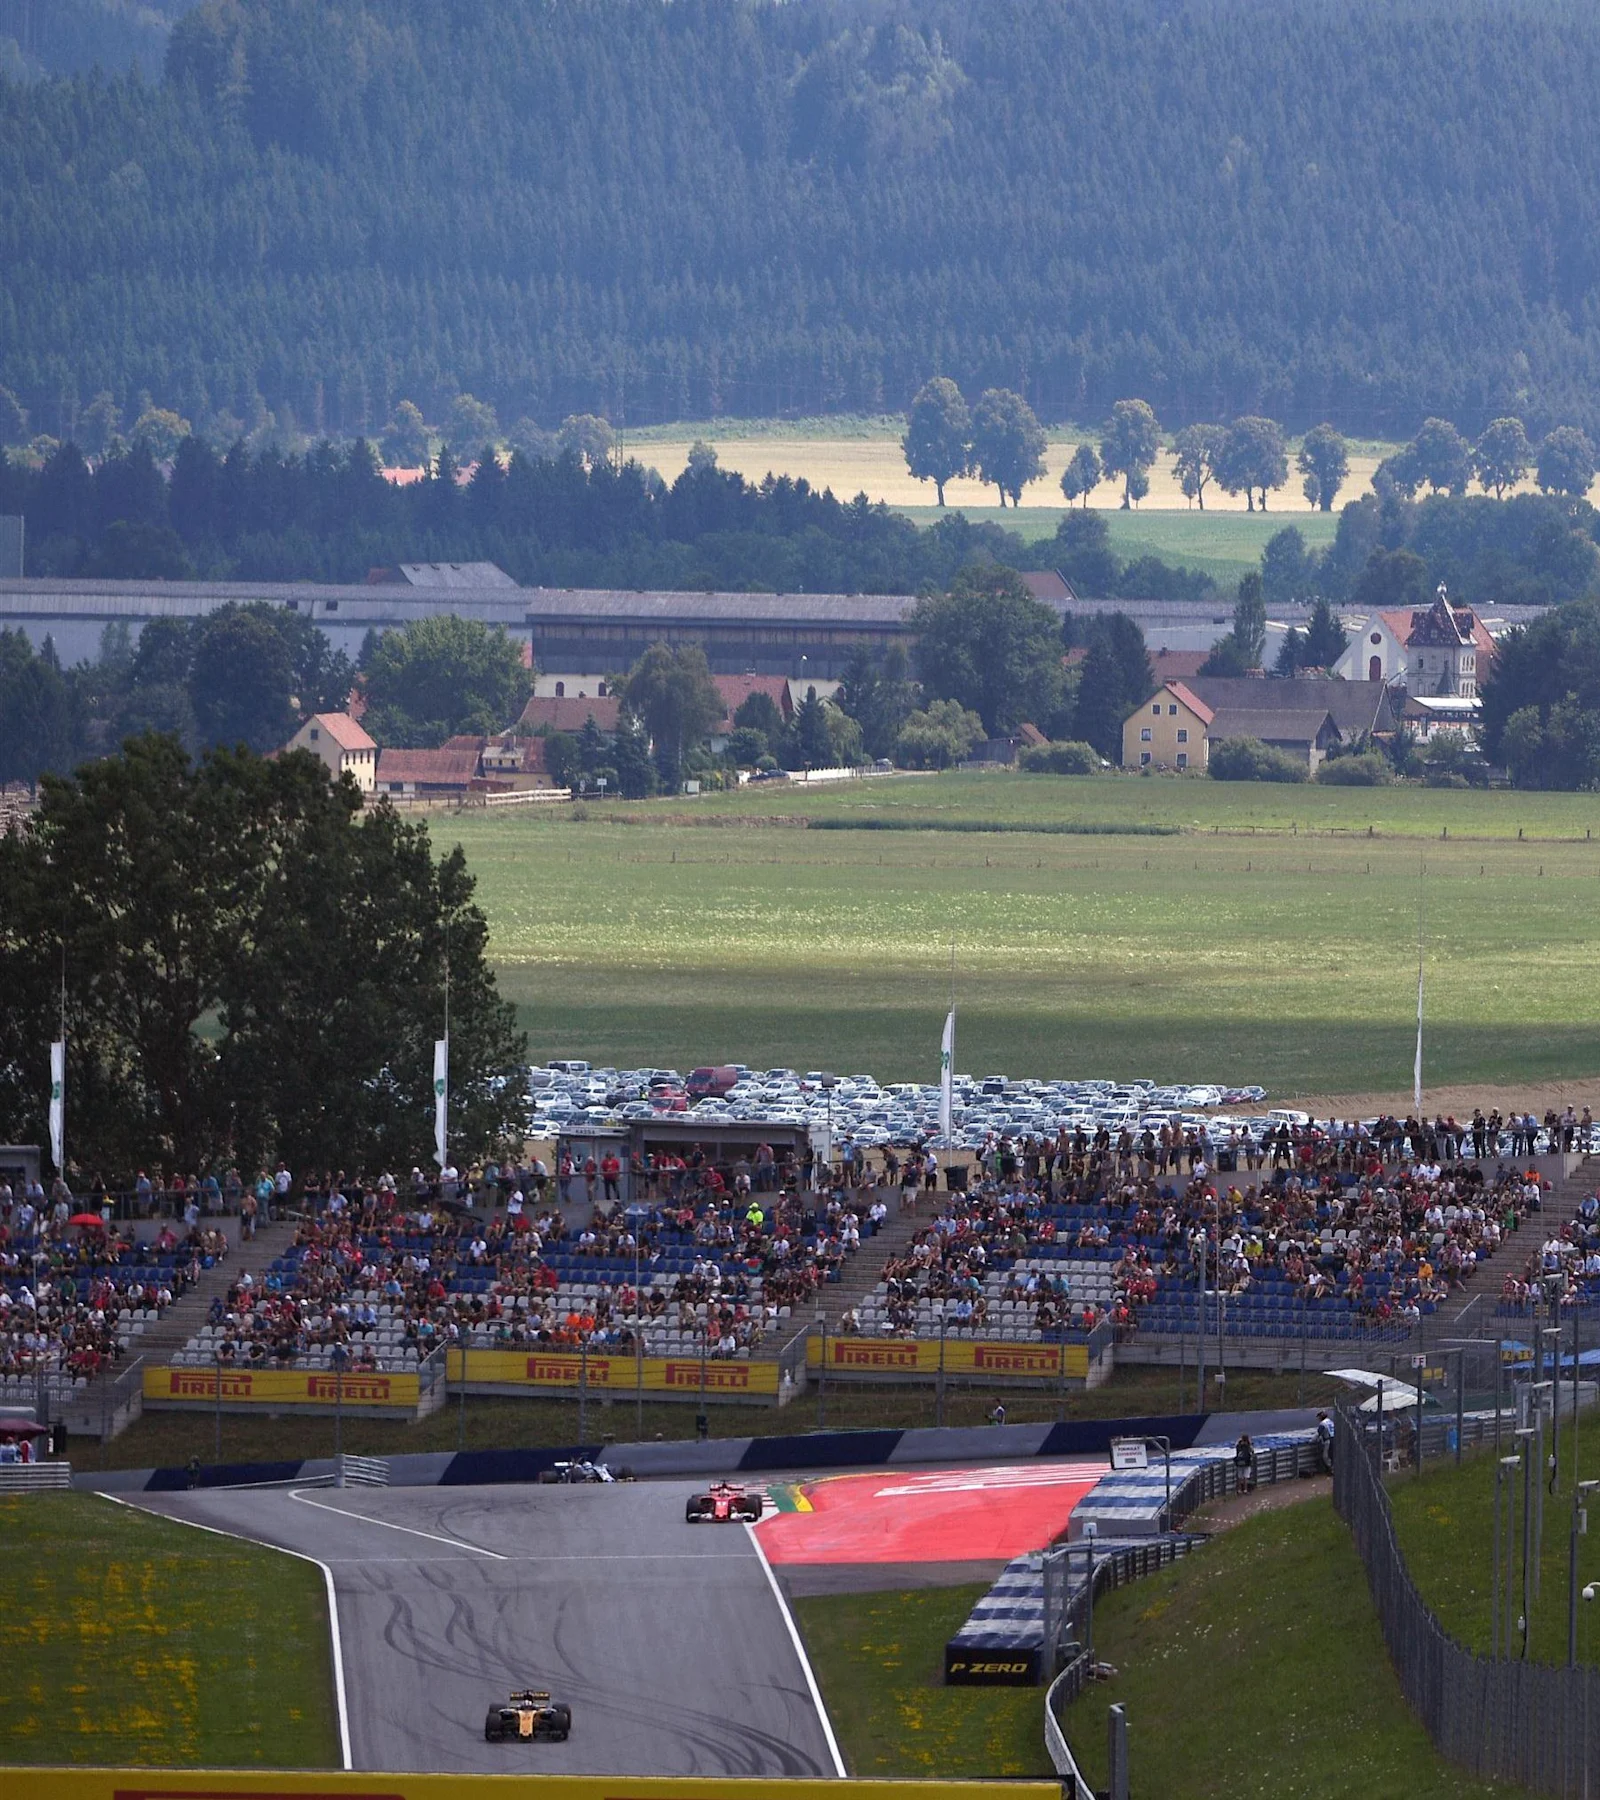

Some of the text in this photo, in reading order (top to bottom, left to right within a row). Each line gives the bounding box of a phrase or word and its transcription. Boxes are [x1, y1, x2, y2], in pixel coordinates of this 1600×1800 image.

[835, 1342, 918, 1366] PIRELLI
[974, 1346, 1059, 1370] PIRELLI
[170, 1372, 253, 1397] PIRELLI
[665, 1363, 750, 1387] PIRELLI
[307, 1376, 391, 1400] PIRELLI
[950, 1663, 1028, 1673] P ZERO
